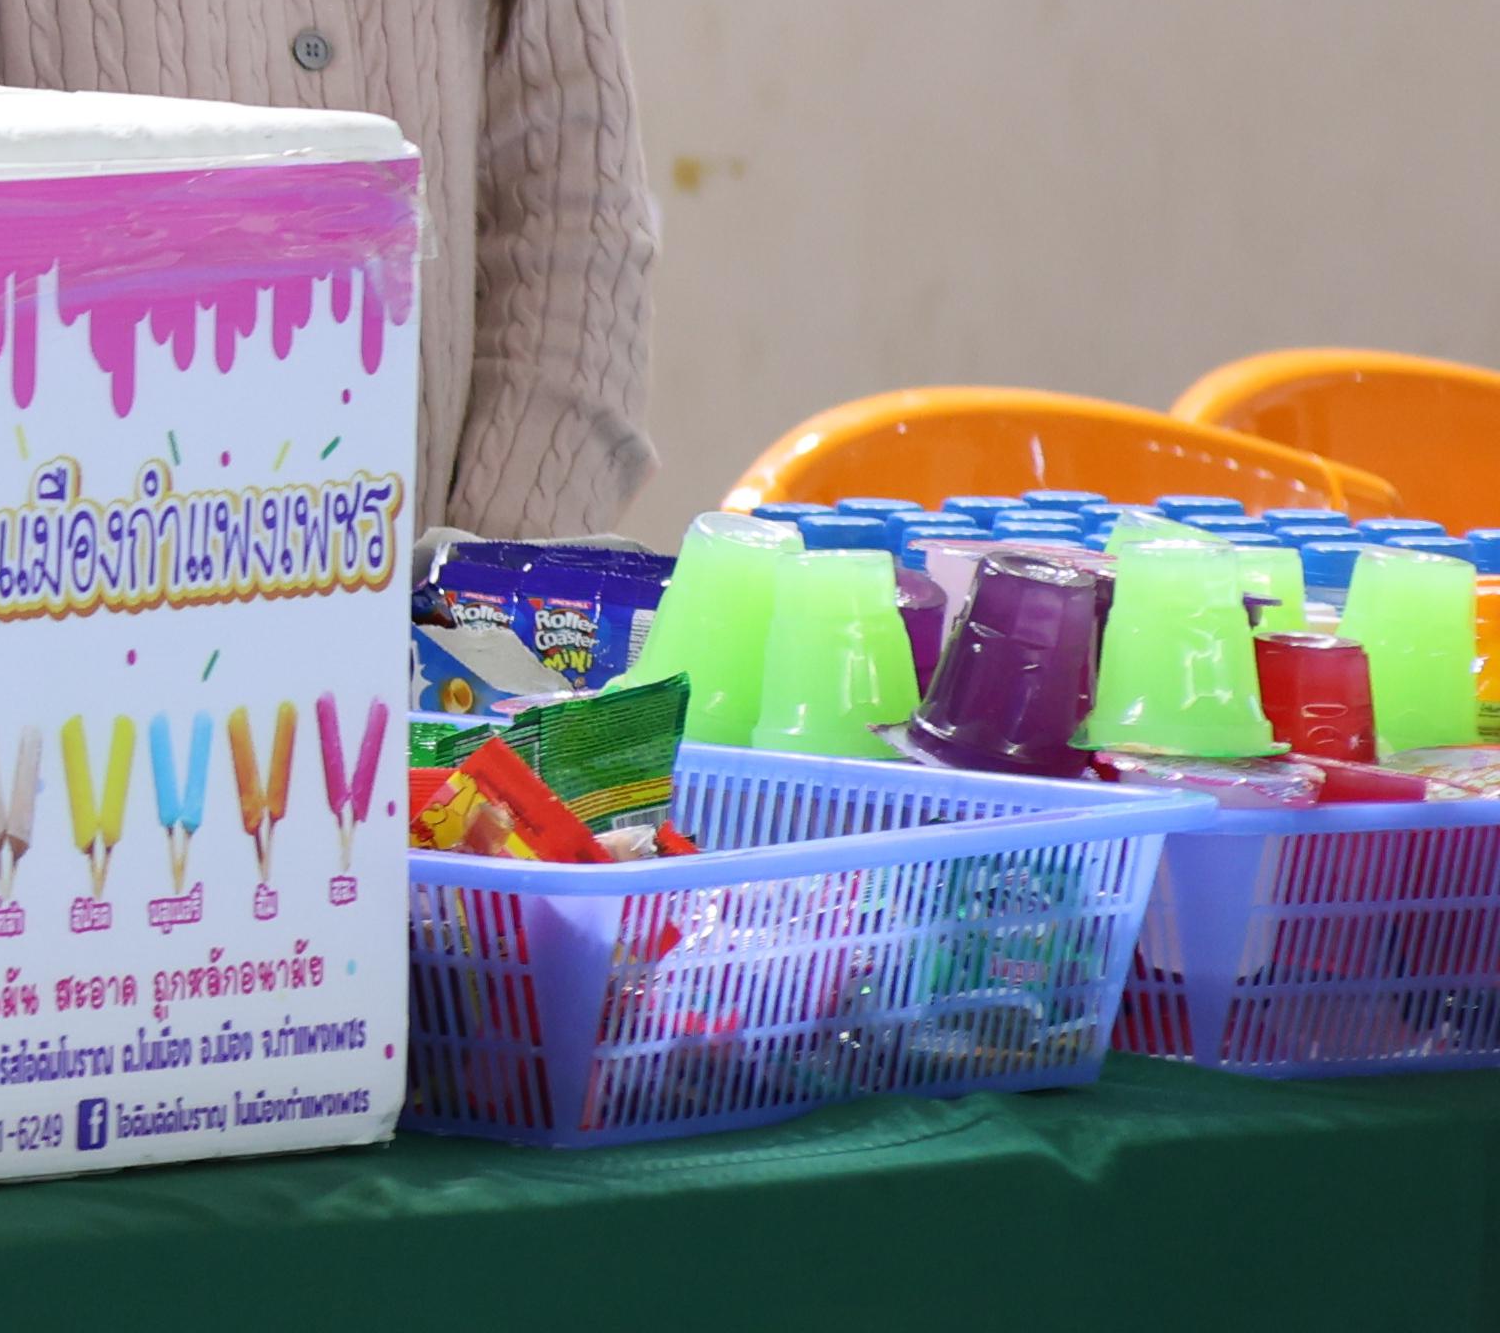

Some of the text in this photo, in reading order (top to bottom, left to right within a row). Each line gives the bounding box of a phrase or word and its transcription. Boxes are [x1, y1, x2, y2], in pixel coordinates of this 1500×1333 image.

[534, 610, 600, 634] Roller
[534, 631, 601, 651] Coaster
[55, 974, 137, 1012] สะอาด
[152, 939, 323, 1020] ถูกหลักอนามัย
